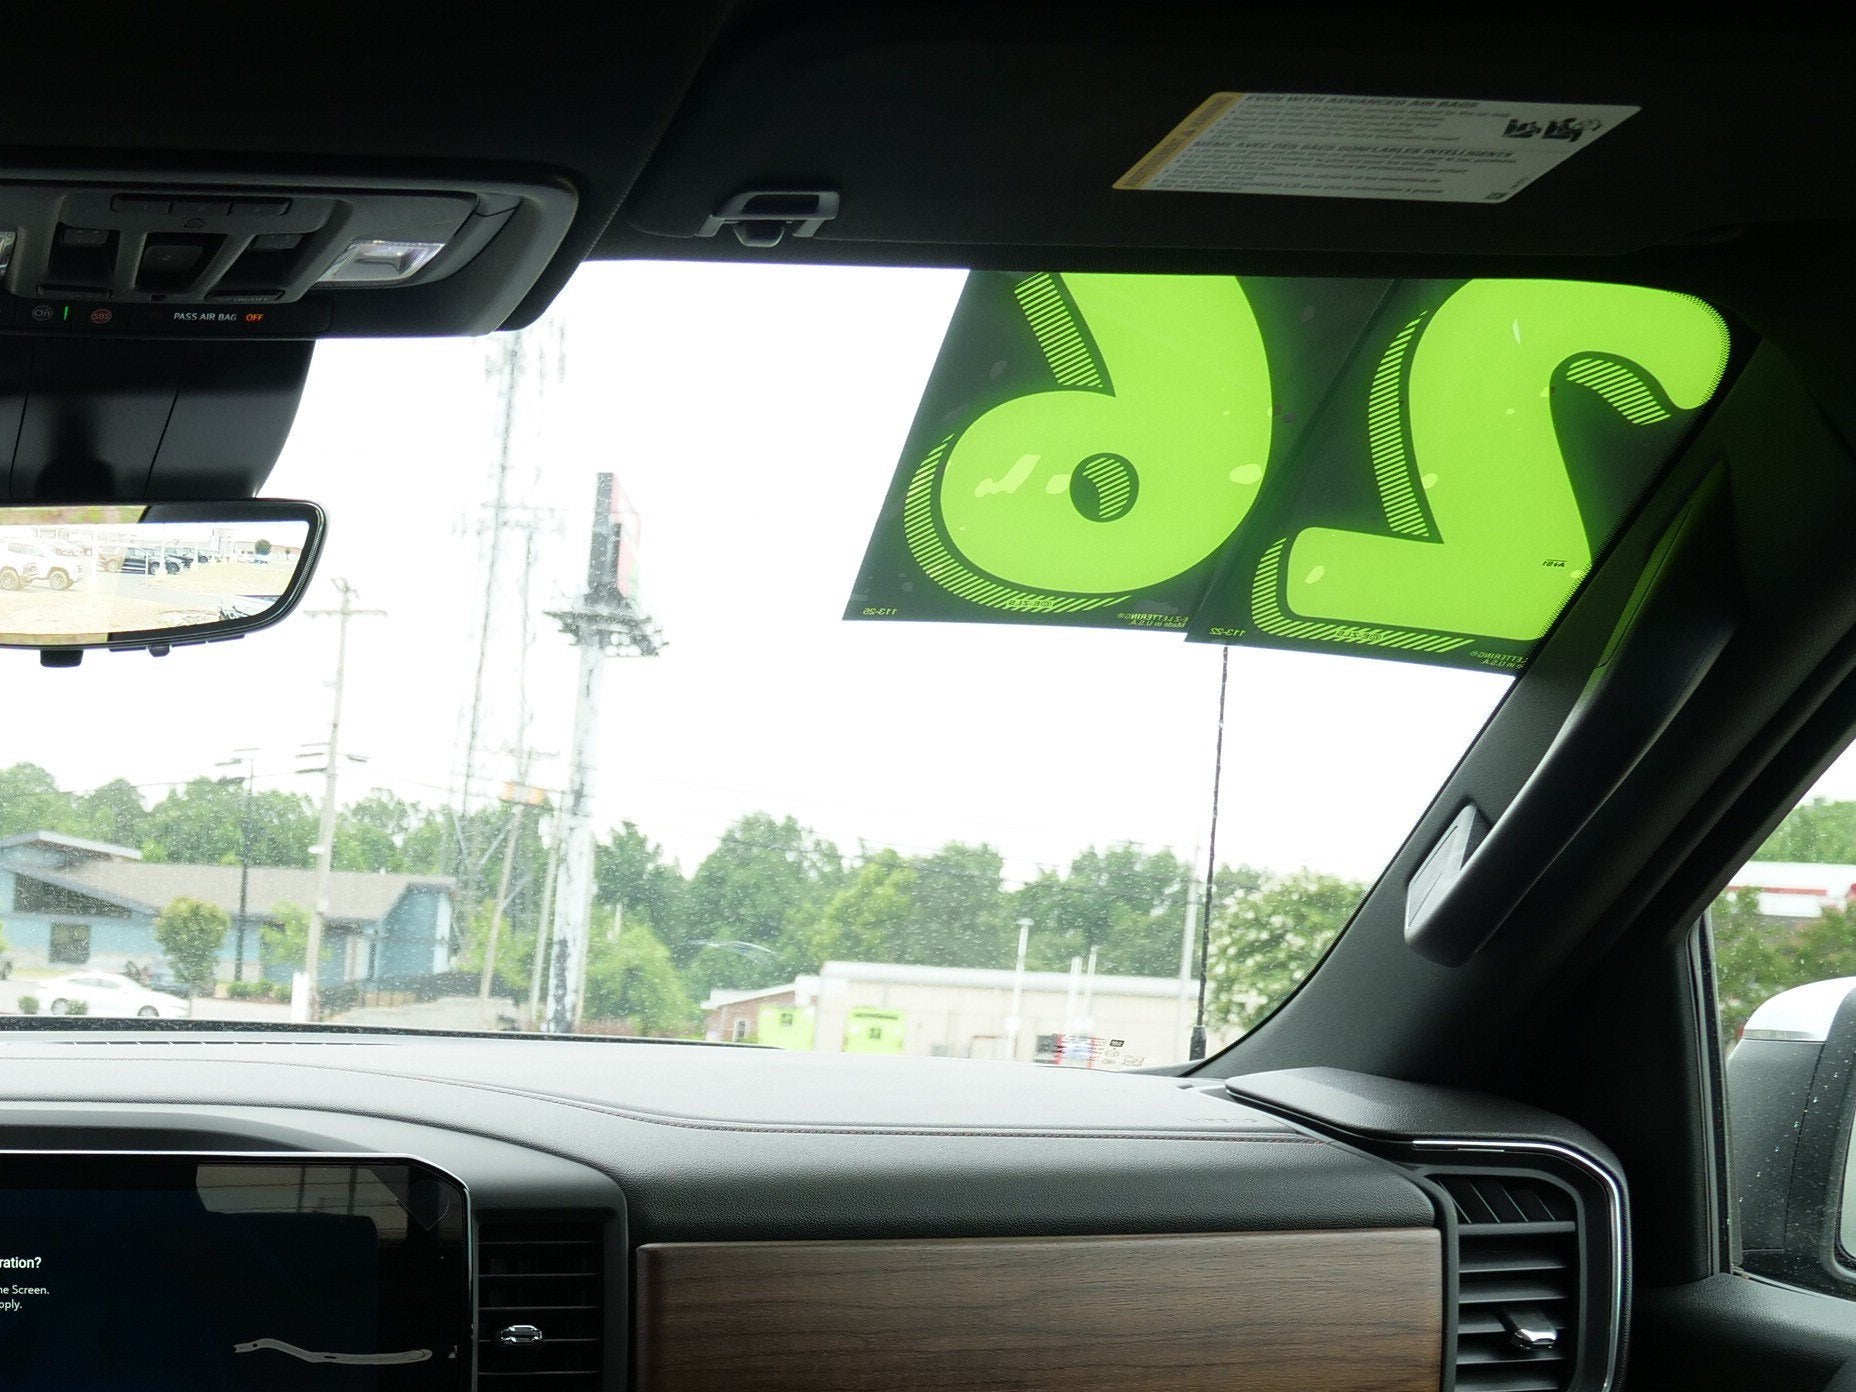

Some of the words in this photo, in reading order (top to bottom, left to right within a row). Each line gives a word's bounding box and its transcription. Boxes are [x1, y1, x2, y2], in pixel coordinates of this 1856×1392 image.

[174, 312, 197, 321] PASS
[199, 312, 216, 321] AIR
[219, 313, 237, 321] BAG
[245, 313, 264, 322] OFF
[11, 1284, 50, 1295] Screen.
